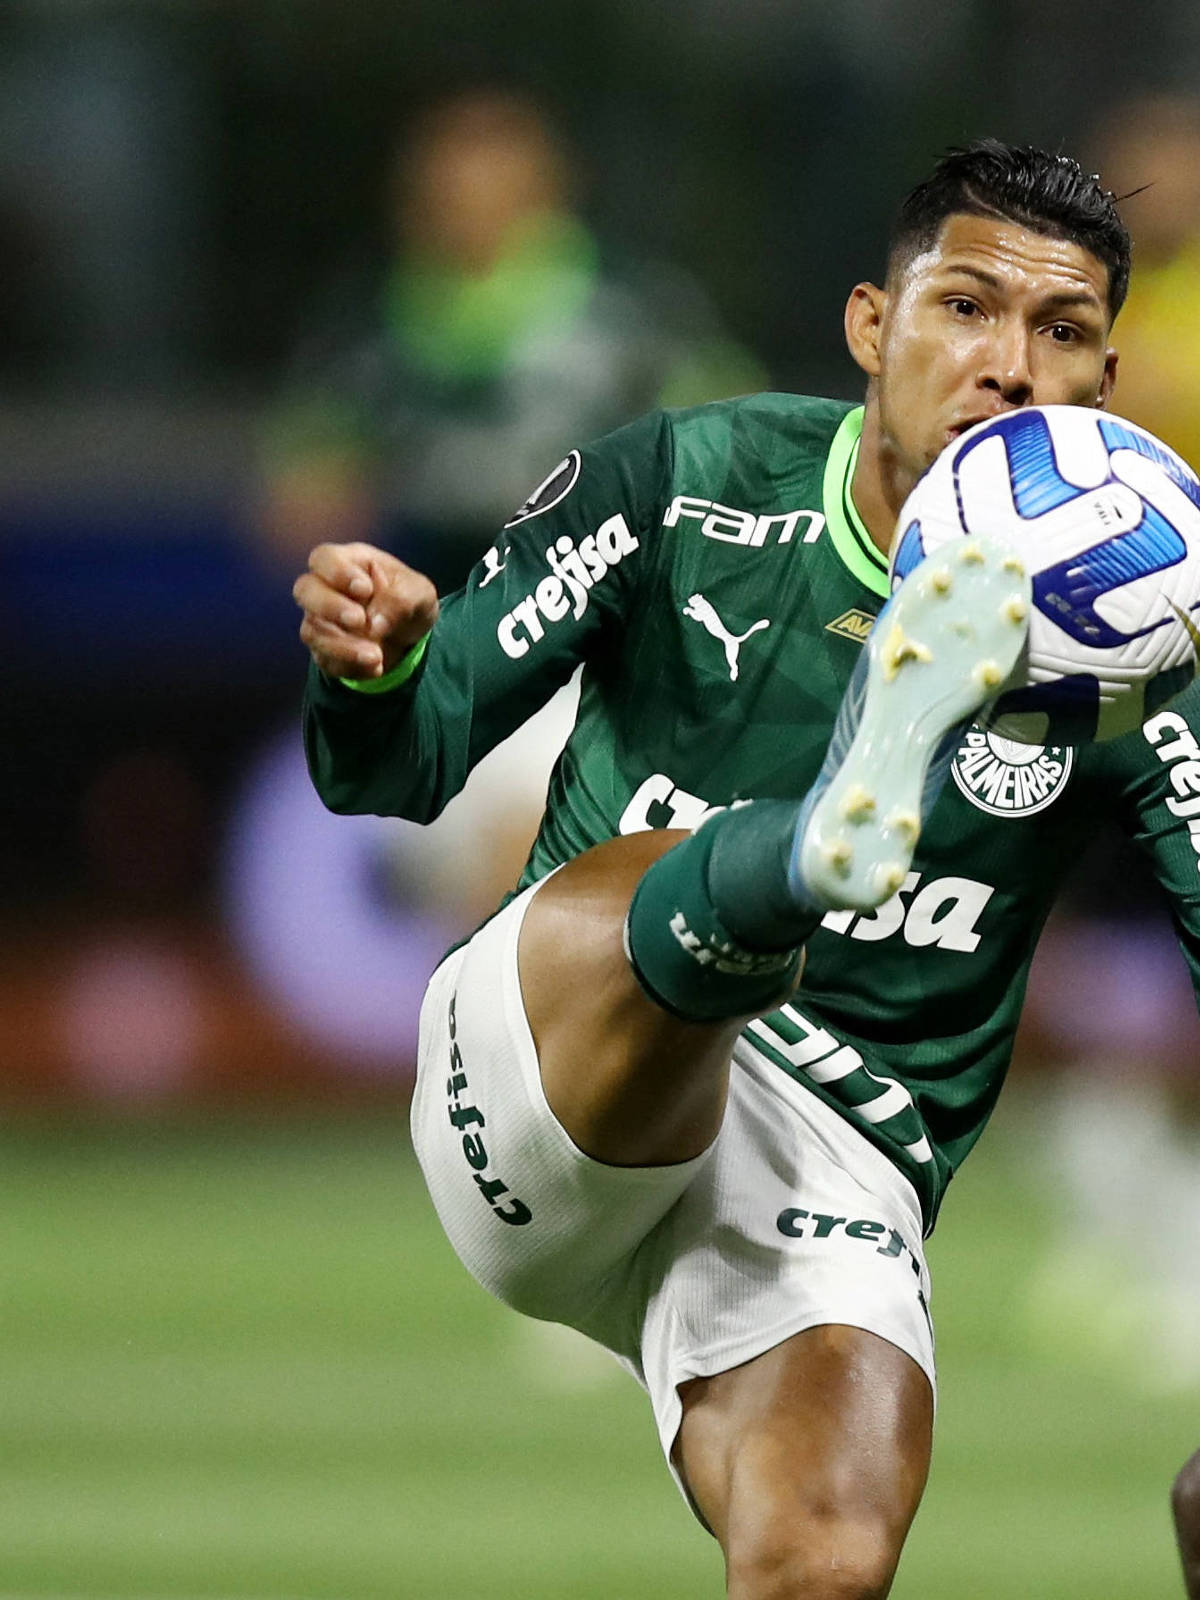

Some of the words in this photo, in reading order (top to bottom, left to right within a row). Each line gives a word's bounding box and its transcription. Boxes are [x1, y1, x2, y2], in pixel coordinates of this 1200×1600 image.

[662, 496, 826, 547] Fam
[497, 513, 640, 659] crefisa
[958, 732, 1063, 808] PALMEIRAS
[447, 988, 533, 1226] crefisa
